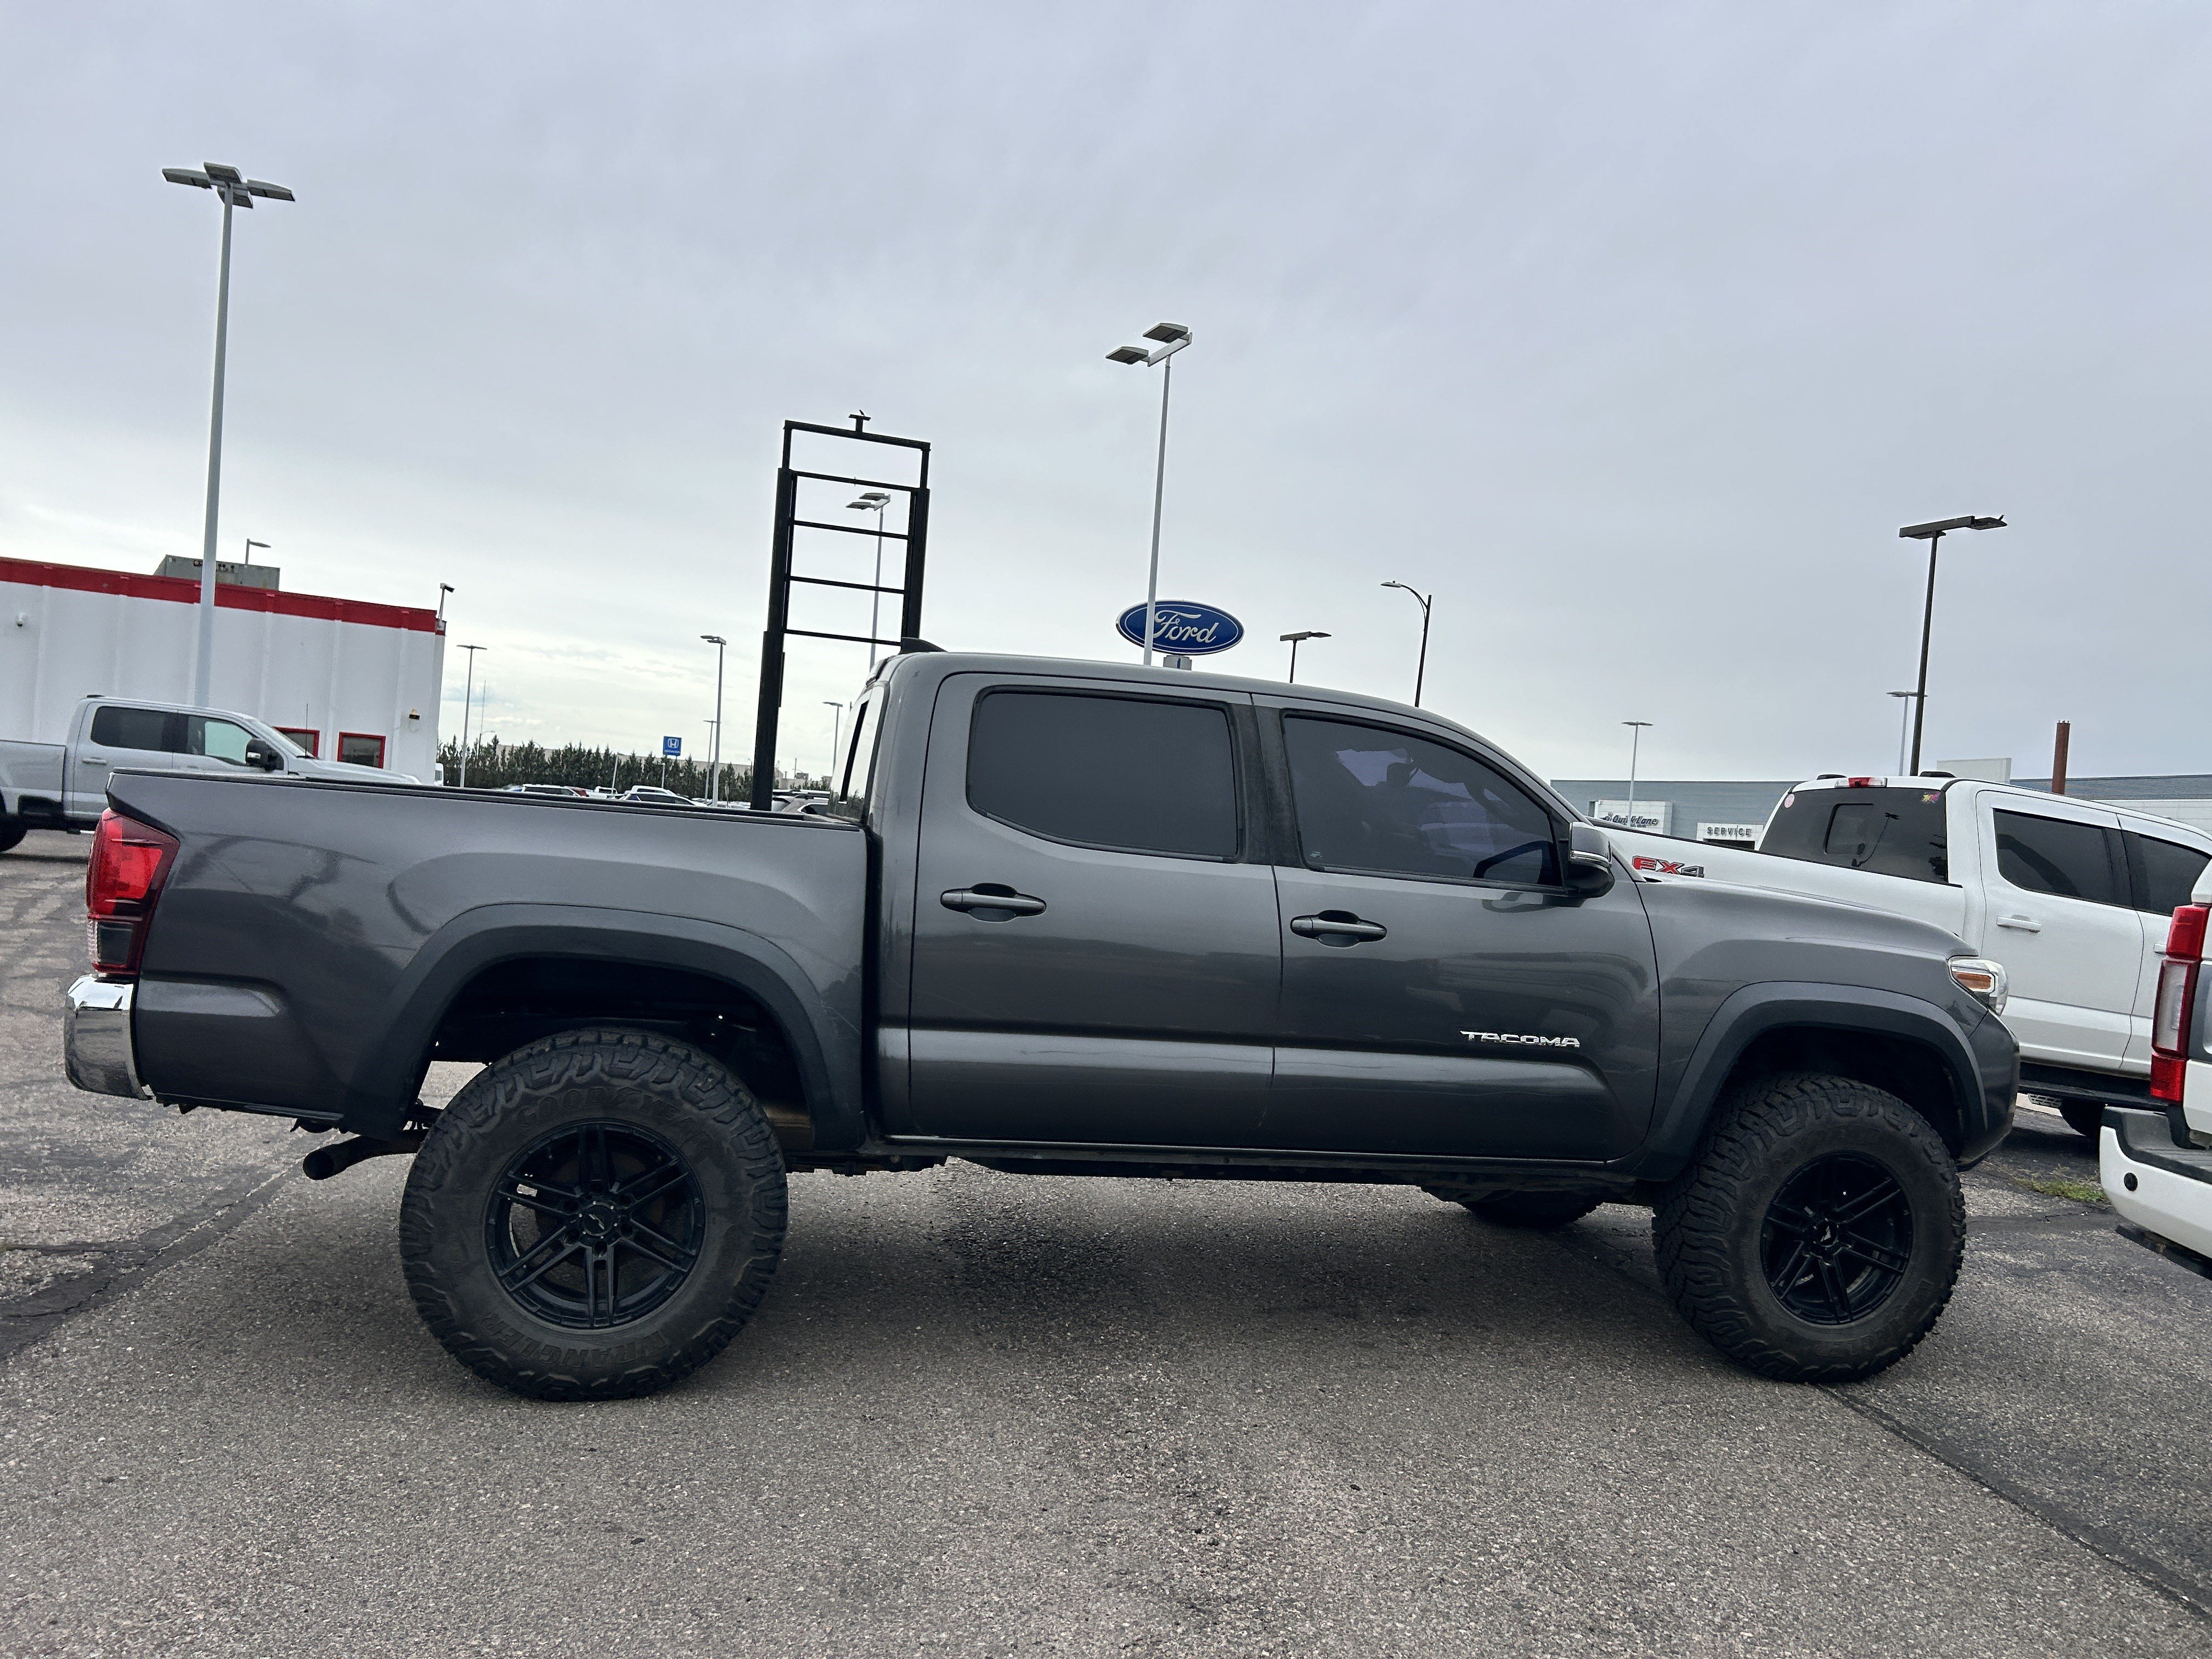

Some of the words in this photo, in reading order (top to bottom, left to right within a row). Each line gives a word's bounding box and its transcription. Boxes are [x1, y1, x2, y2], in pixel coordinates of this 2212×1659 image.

[1153, 610, 1219, 643] Ford
[1612, 815, 1637, 824] Quik
[1707, 827, 1752, 836] SERVICE
[1632, 855, 1704, 878] FX4
[1460, 1030, 1580, 1048] TACOMA
[481, 1313, 670, 1368] WRANGLER
